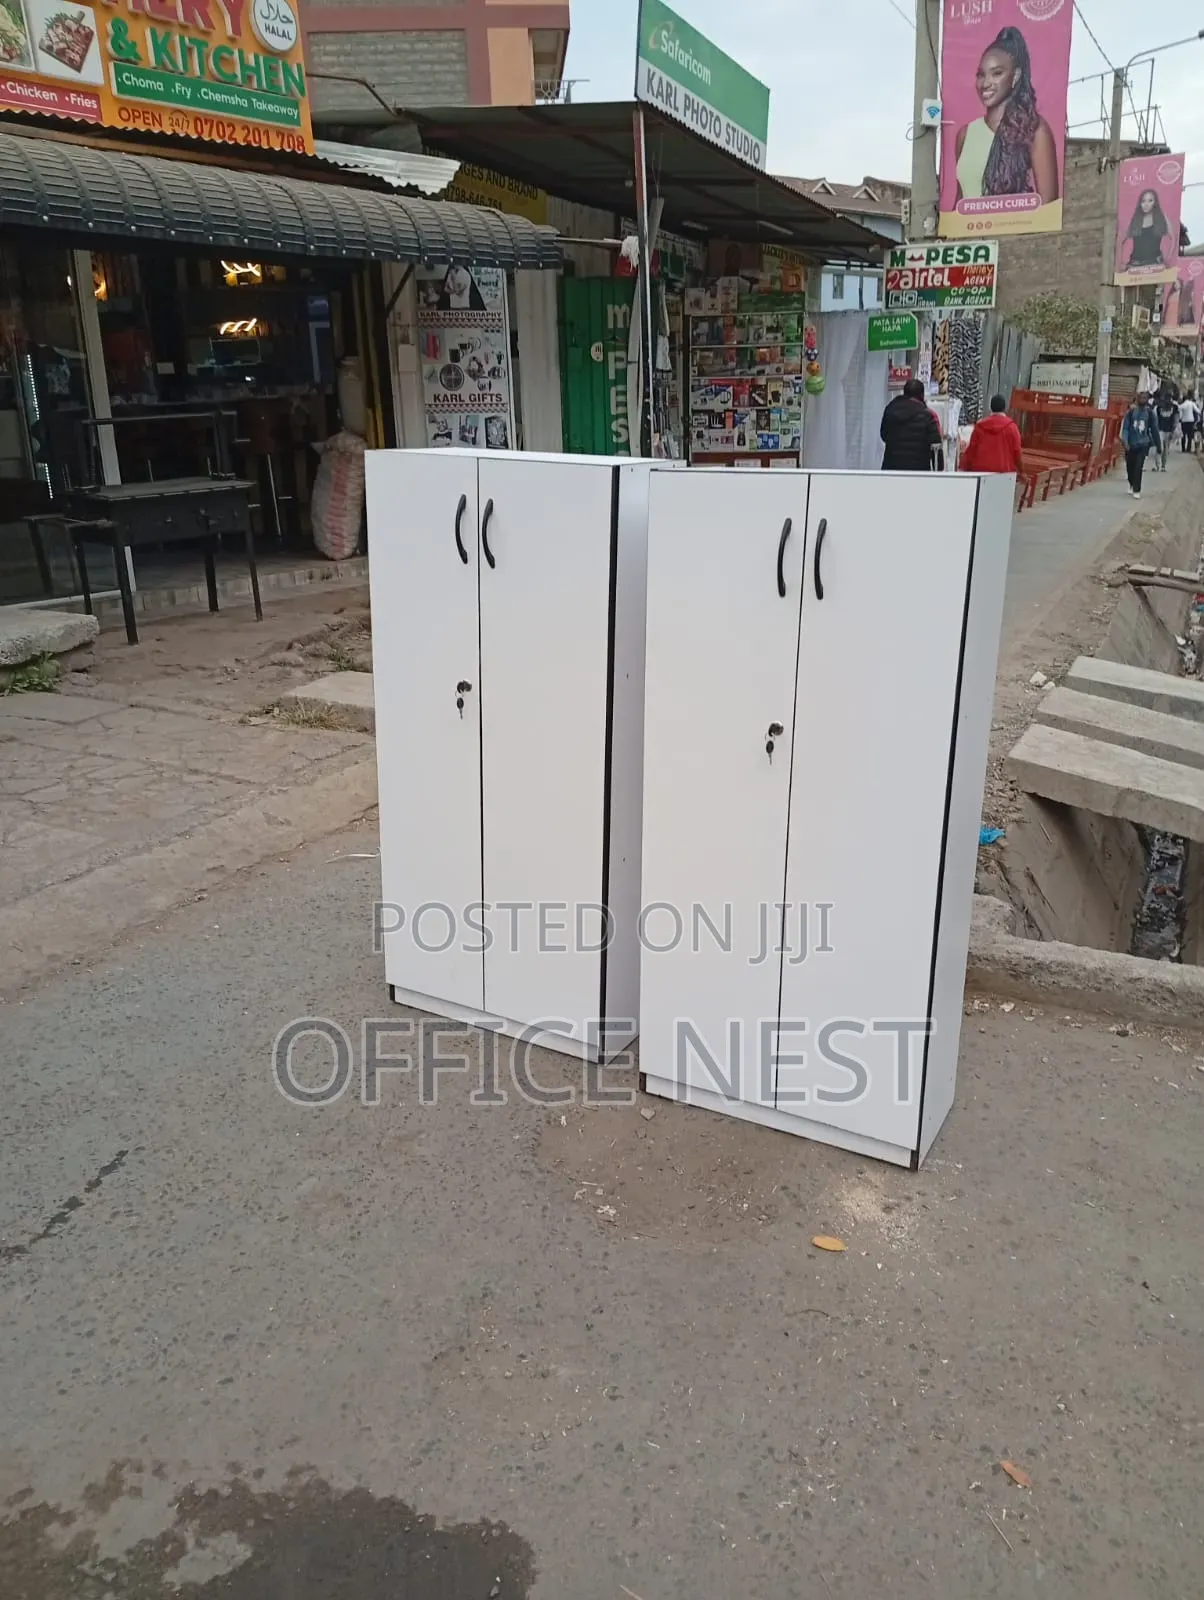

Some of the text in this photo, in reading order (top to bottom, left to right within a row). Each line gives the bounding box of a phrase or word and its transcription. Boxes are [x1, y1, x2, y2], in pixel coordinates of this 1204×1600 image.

[264, 22, 292, 41] HALAL
[107, 16, 306, 99] & KITCHEN
[661, 29, 711, 86] Safaricom
[6, 81, 98, 109] Chicken Fries
[122, 72, 299, 120] Choma Fry Chemsha Takeaway
[646, 66, 761, 165] KARL PHOTO STUDIO
[118, 106, 306, 154] OPEN 24/7 0702 201 708
[486, 169, 506, 189] AND
[508, 176, 539, 201] BRAND
[964, 197, 1037, 211] FRENCH CURLS
[951, 286, 986, 296] CO-OP
[964, 275, 993, 286] AGENT
[944, 295, 992, 306] BANK AGENT
[873, 316, 911, 327] PATA LAINI
[433, 393, 503, 403] KARL GIFTS
